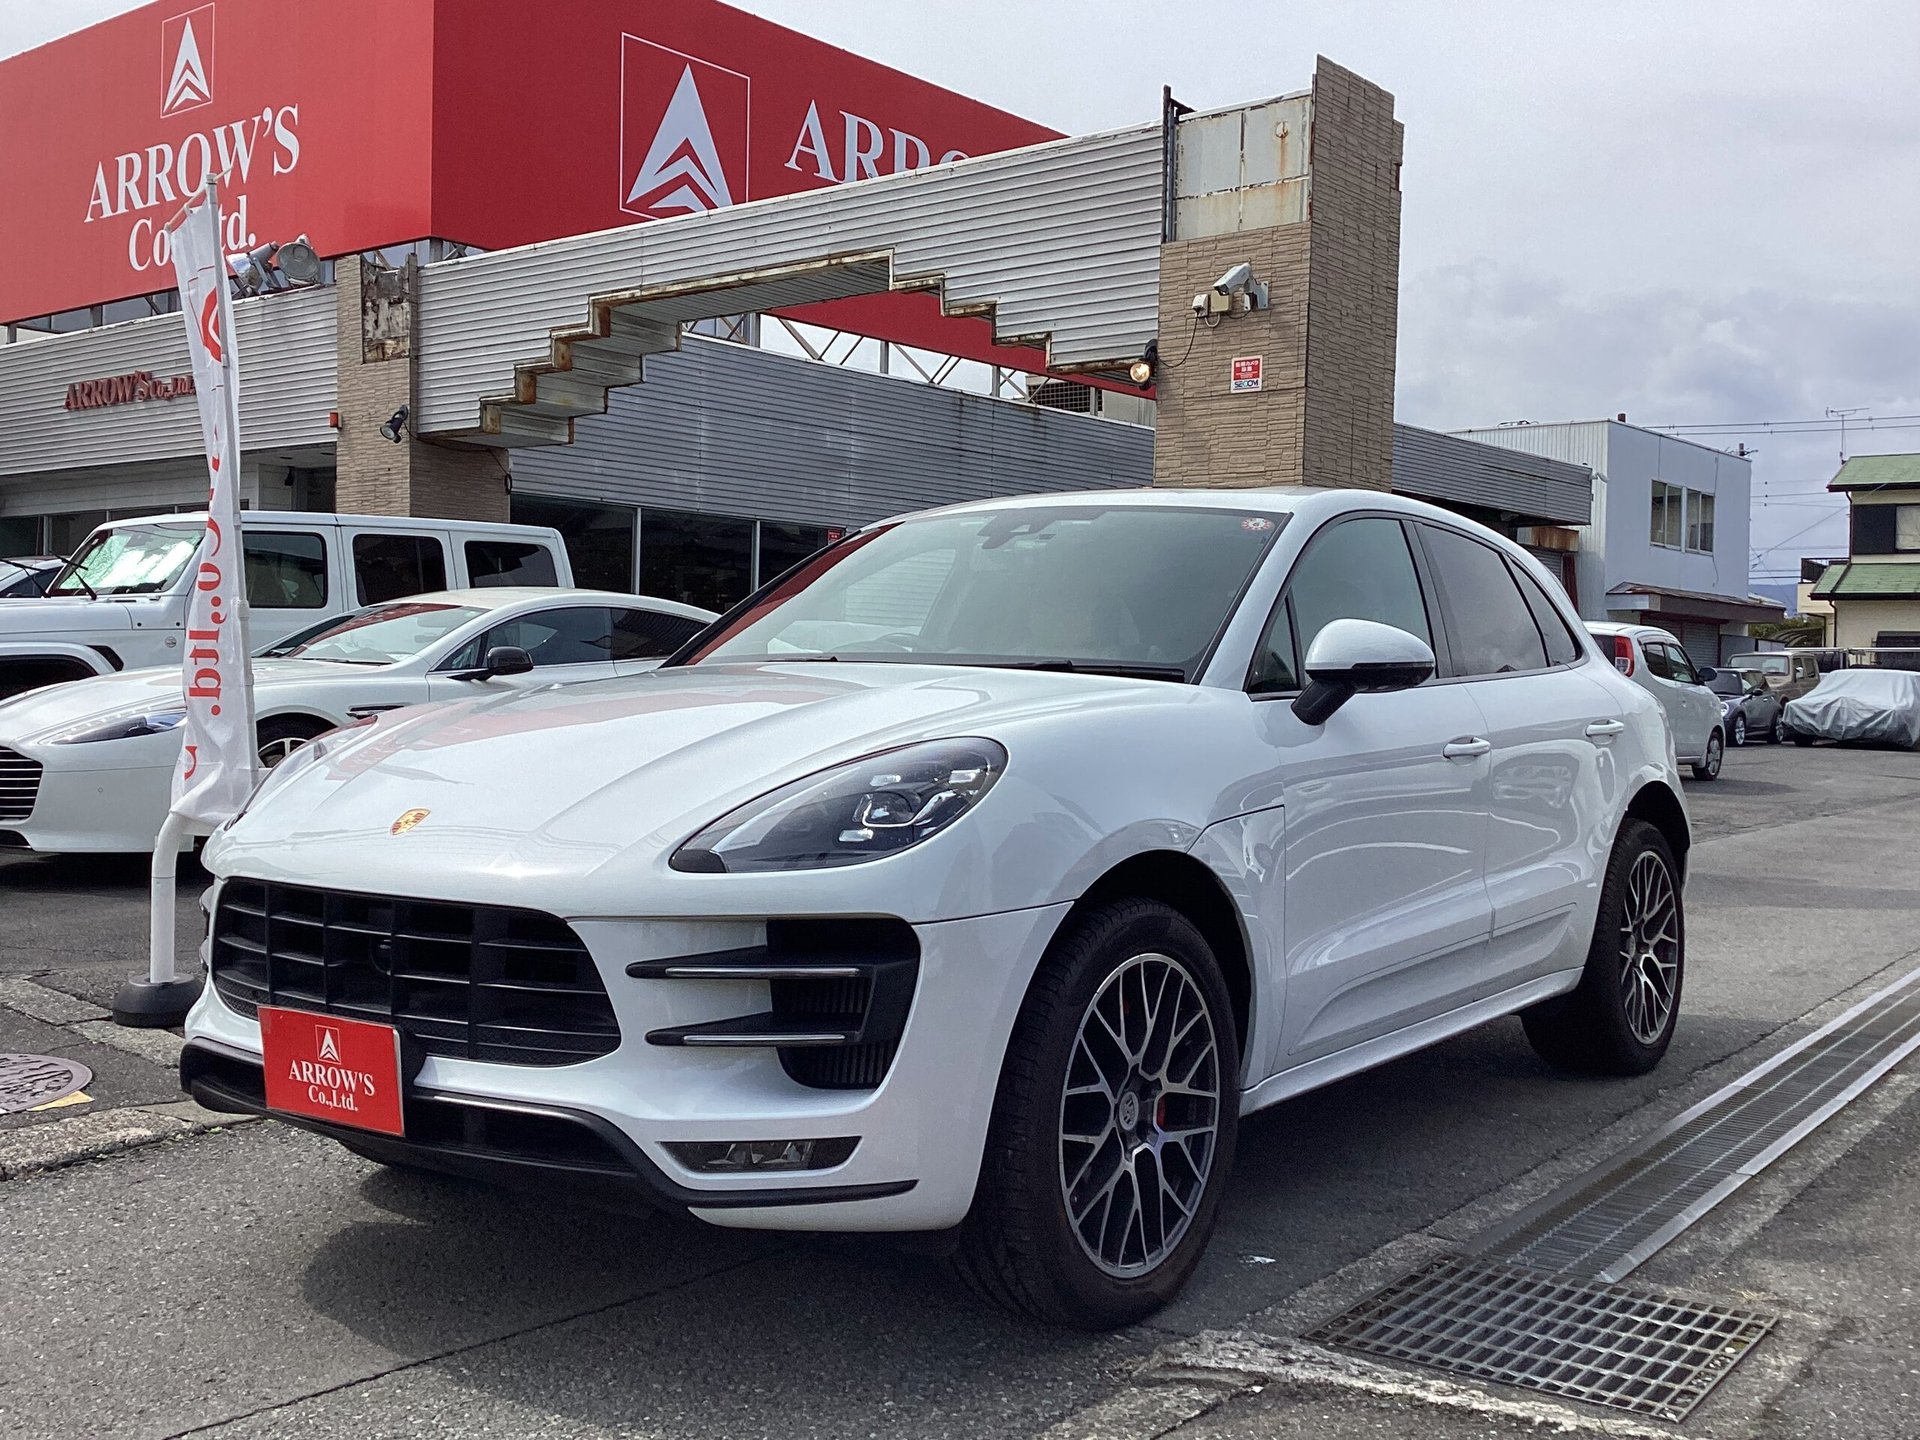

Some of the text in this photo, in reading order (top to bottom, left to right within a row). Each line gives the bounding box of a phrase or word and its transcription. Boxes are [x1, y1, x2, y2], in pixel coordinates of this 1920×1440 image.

[84, 104, 300, 223] ARROW'S
[784, 99, 970, 184] ARR
[129, 194, 257, 272] Cotd.
[64, 371, 153, 411] ARROW'S
[288, 1059, 375, 1097] ARROW'S
[308, 1085, 358, 1112] Co.,Ltd.
